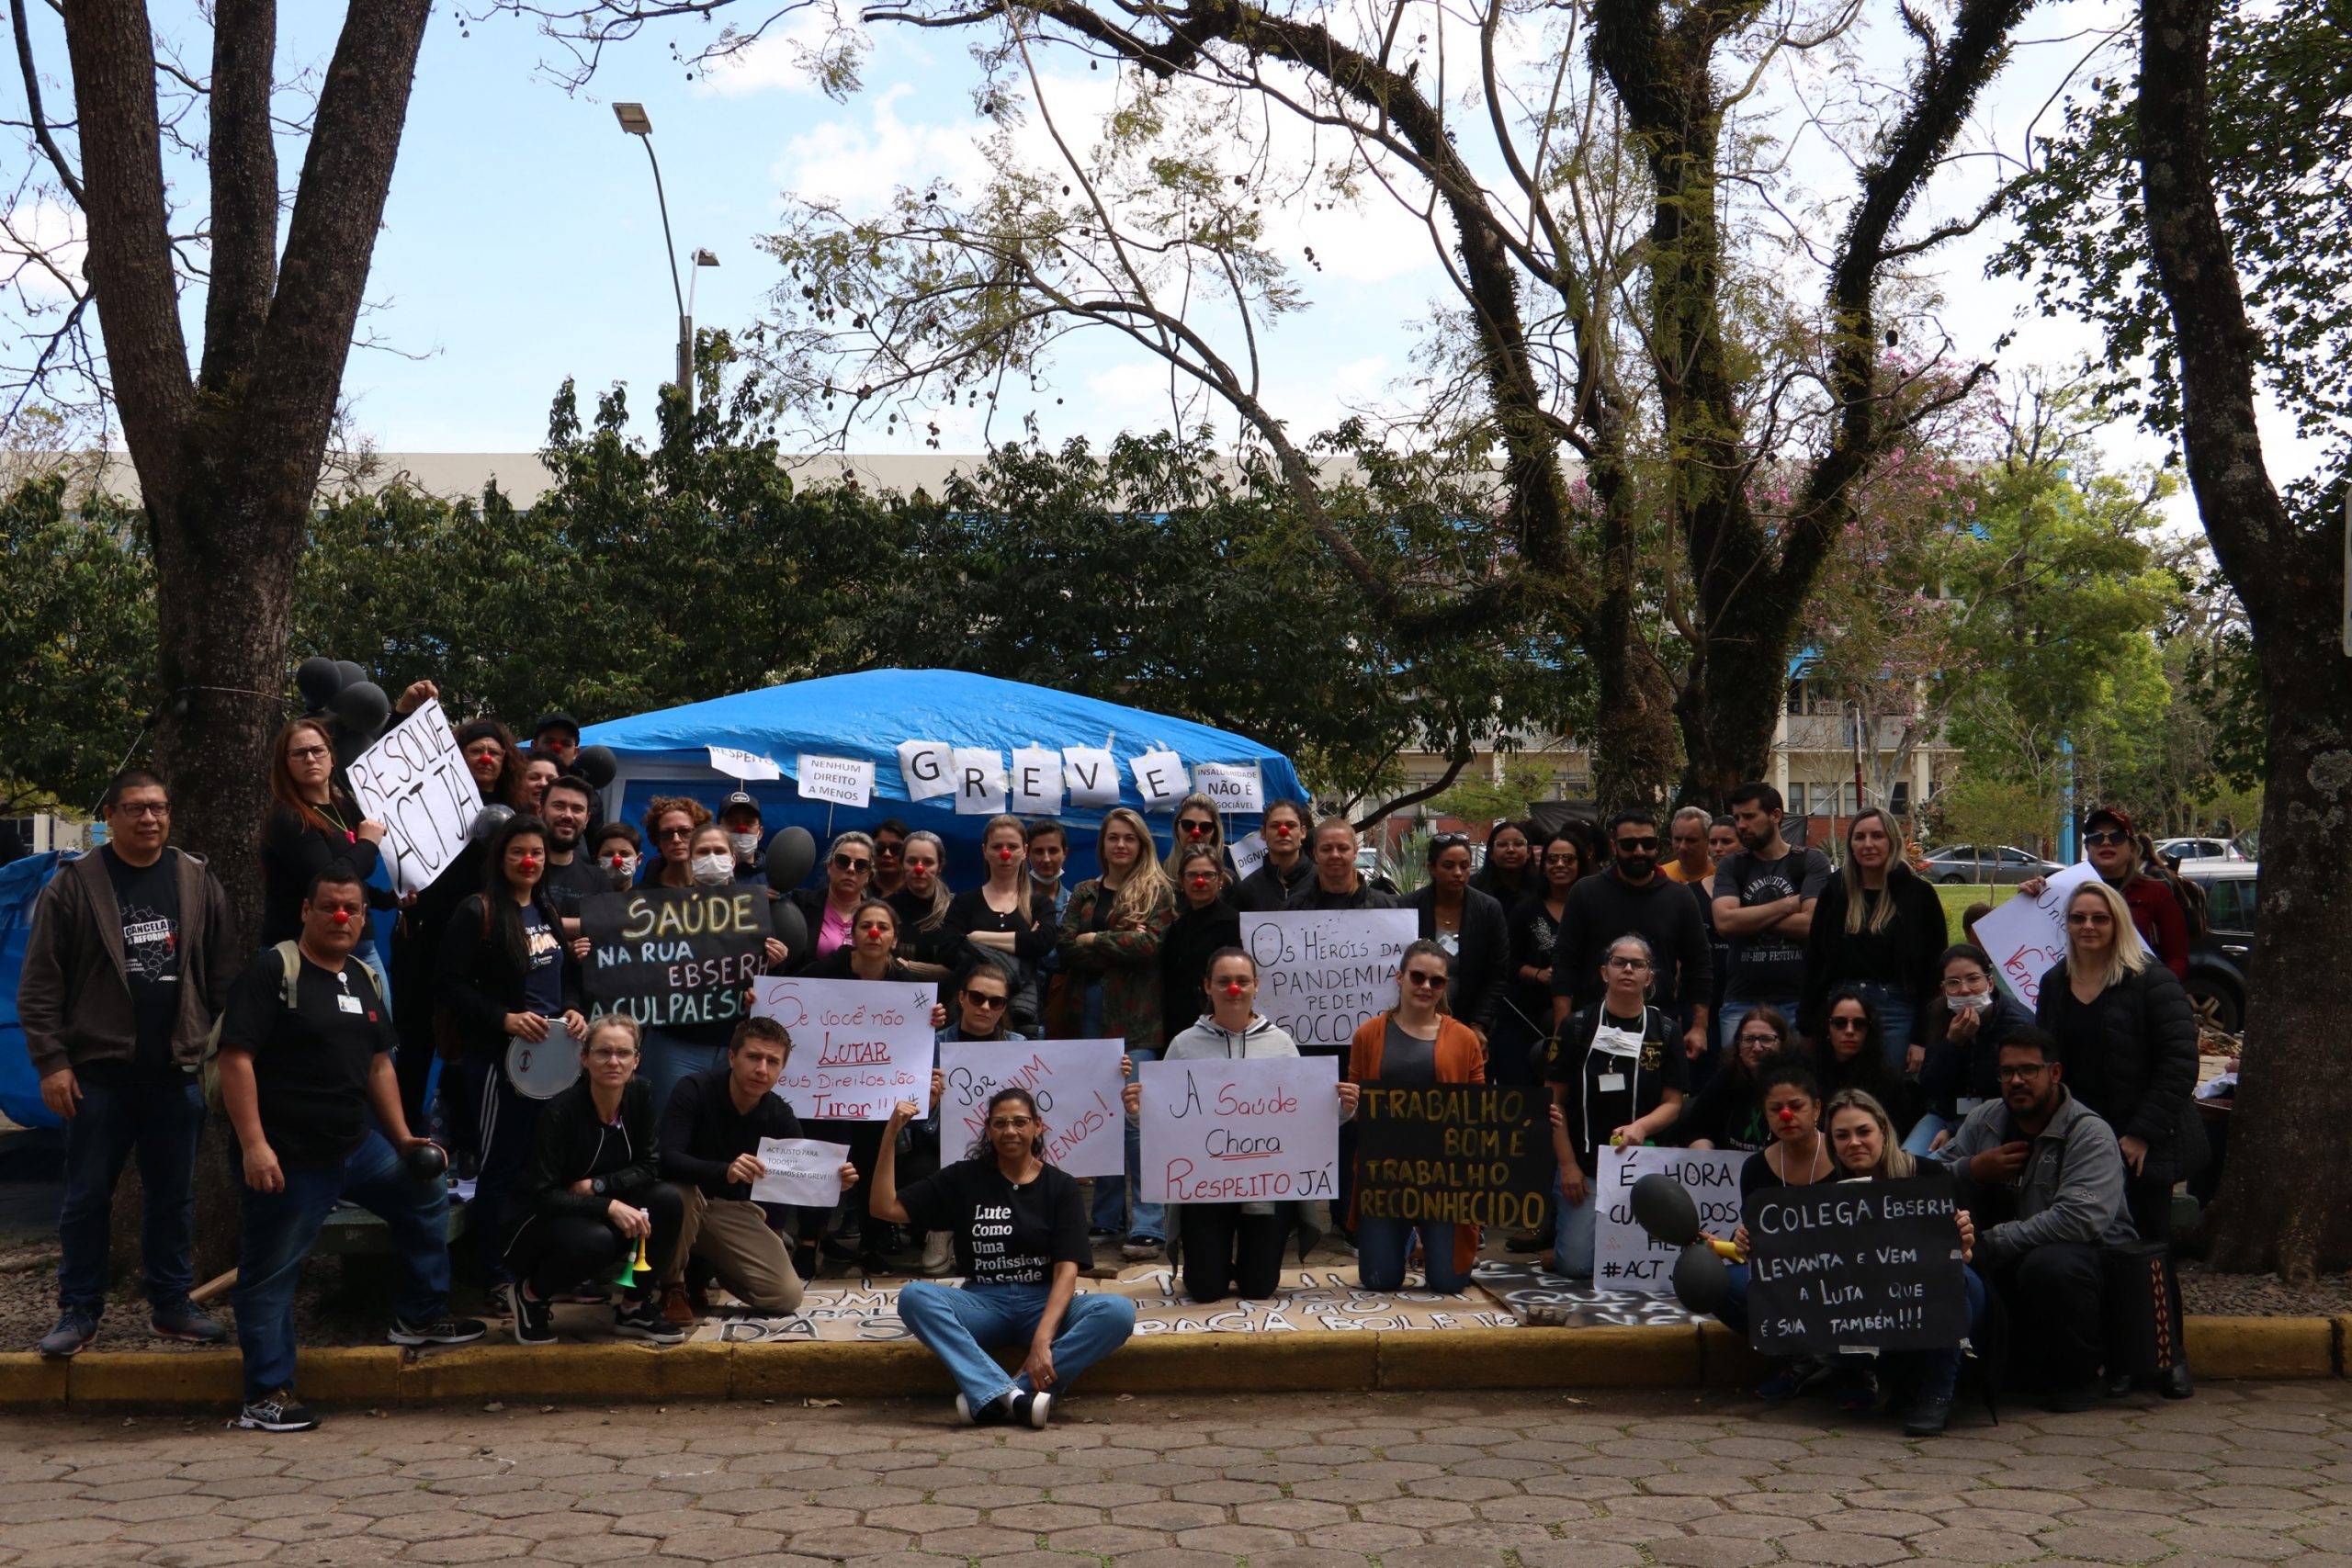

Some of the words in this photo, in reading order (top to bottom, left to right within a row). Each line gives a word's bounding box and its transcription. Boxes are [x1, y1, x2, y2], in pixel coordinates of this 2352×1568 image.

[353, 705, 455, 813] RESOLVE
[811, 760, 861, 773] NENHUM
[813, 773, 856, 785] DIREITO
[911, 750, 1170, 798] GREVE
[819, 787, 858, 800] MENOS
[1208, 780, 1241, 795] NÃO
[1245, 782, 1252, 795] É
[382, 782, 448, 893] ACT
[434, 754, 479, 840] JÁ
[1238, 848, 1269, 867] DIGNID
[622, 893, 758, 937] SAÚDE
[125, 919, 168, 937] CANCELA
[128, 937, 133, 945] A
[133, 931, 171, 944] REFORMA
[596, 946, 631, 969] NA
[641, 942, 694, 963] RUA
[1381, 943, 1402, 956] DA
[669, 953, 770, 987] EBSERH
[1272, 964, 1396, 997] PANDEMIA
[768, 982, 808, 1029] Se
[872, 1009, 904, 1026] não
[1305, 992, 1373, 1010] PEDEM
[818, 1032, 891, 1065] LUTAR
[777, 1075, 810, 1088] eus
[817, 1070, 886, 1089] Direitos
[812, 1093, 872, 1118] Tirar
[964, 1054, 1053, 1139] NEUM
[1169, 1069, 1202, 1118] A
[1214, 1084, 1297, 1116] Saúde
[780, 1147, 801, 1156] JUSTO
[802, 1149, 818, 1157] PARA
[1205, 1129, 1281, 1156] Chora
[1444, 1127, 1499, 1157] BOM
[1297, 1162, 1332, 1196] JÁ
[1364, 1158, 1510, 1187] TRABALHO
[1620, 1151, 1638, 1186] É
[1665, 1163, 1735, 1187] HORA
[974, 1204, 1012, 1220] Lute
[1360, 1187, 1544, 1229] RECONHECIDO
[1701, 1201, 1738, 1224] DOS
[1758, 1200, 1873, 1234] COLEGA
[971, 1224, 1012, 1237] Como
[972, 1241, 1005, 1254] Uma
[995, 1269, 1043, 1283] Saúde
[1601, 1260, 1664, 1280] #ACT
[1757, 1253, 1845, 1282] LEVANTA
[1876, 1246, 1917, 1264] VEM
[1799, 1287, 1810, 1301] A
[1820, 1279, 1864, 1304] LUTA
[1888, 1283, 1923, 1300] QUE
[719, 1319, 818, 1341] DA
[1132, 1311, 1301, 1335] PAGA
[1317, 1309, 1521, 1331] BOLETO
[1760, 1319, 1769, 1337] É
[1777, 1318, 1806, 1337] SUA
